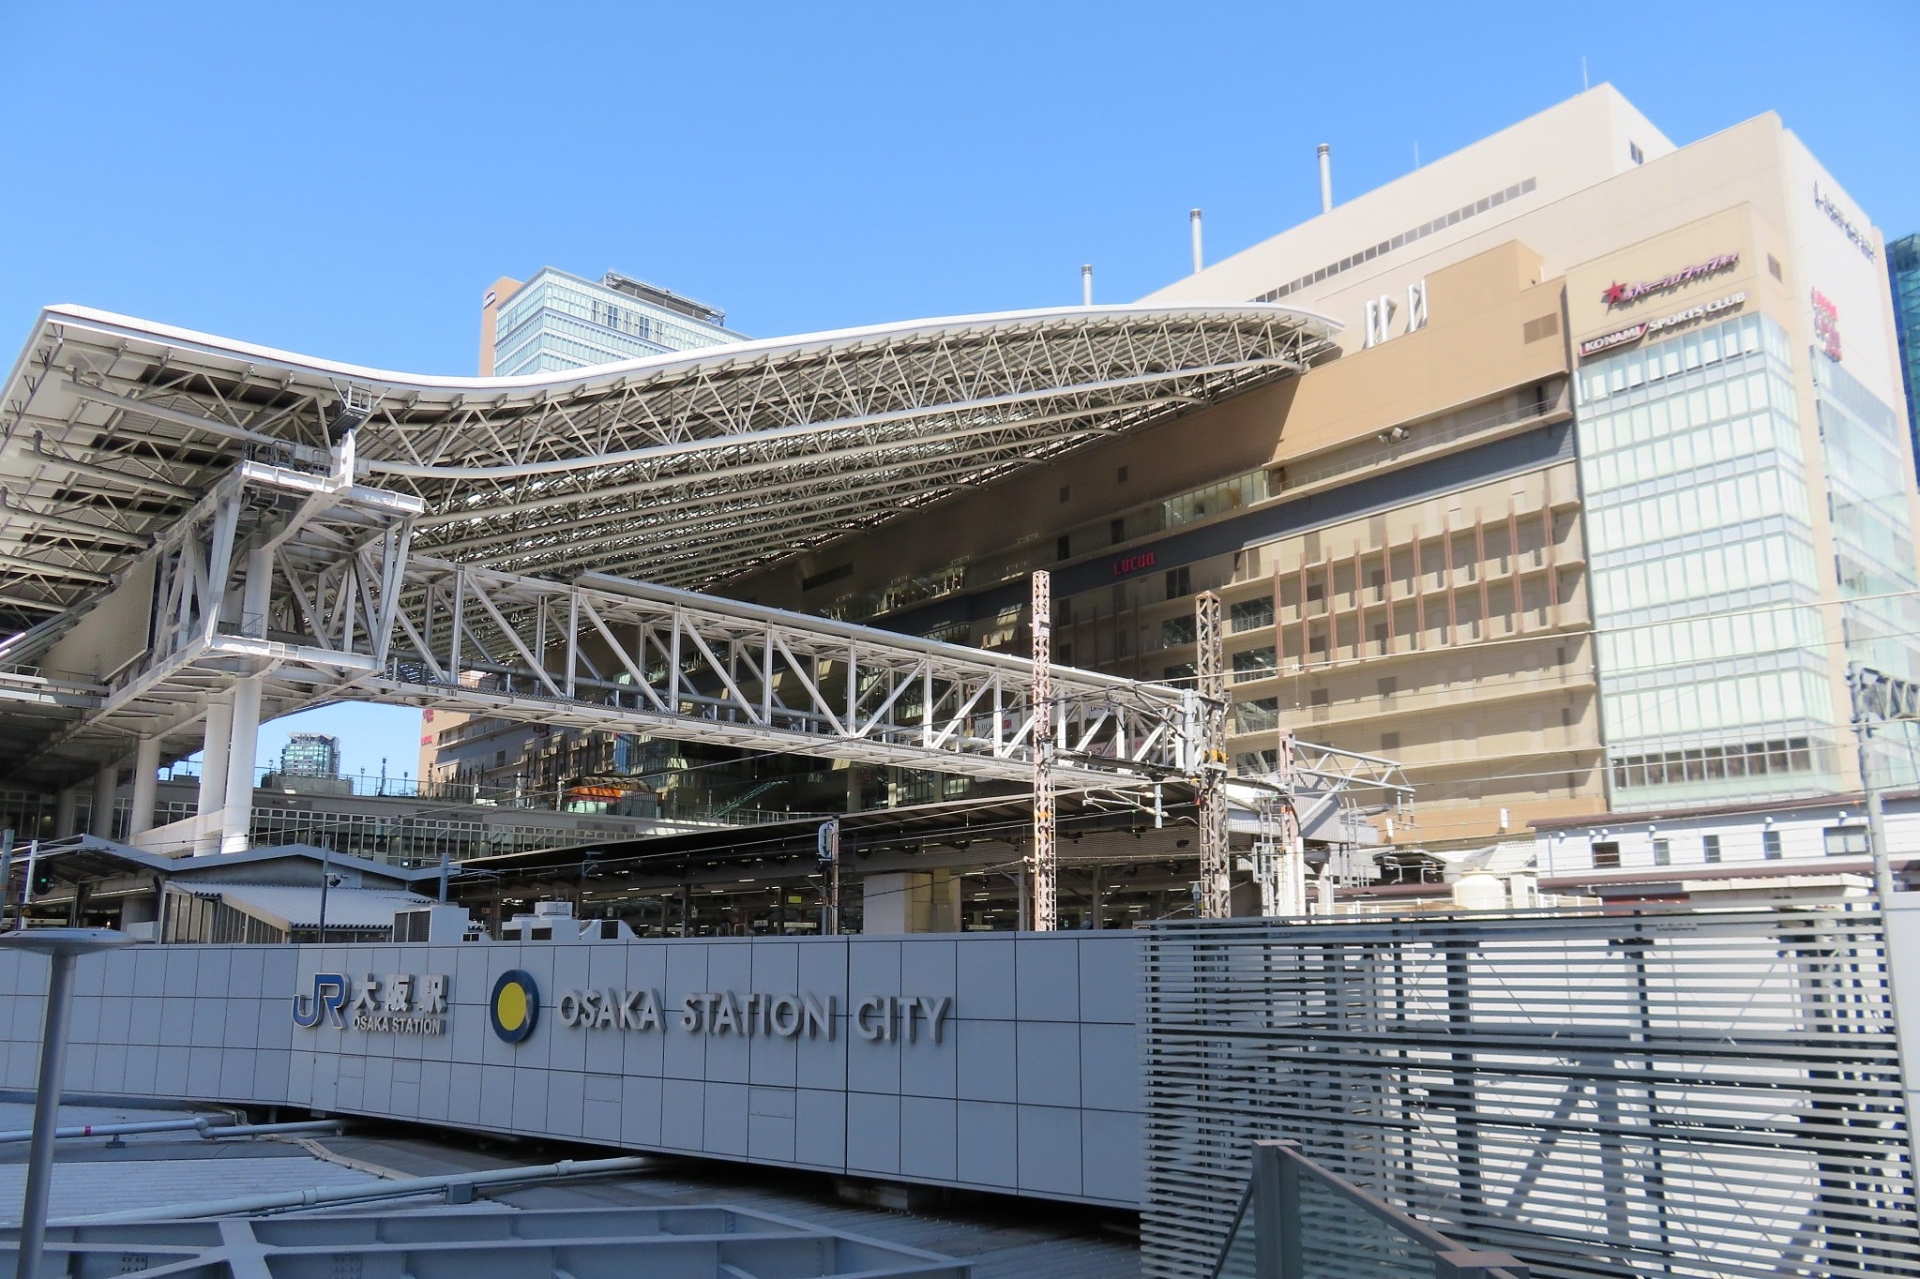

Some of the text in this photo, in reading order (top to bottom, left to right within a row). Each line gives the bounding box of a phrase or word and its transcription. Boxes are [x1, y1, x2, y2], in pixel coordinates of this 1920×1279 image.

[1584, 291, 1746, 352] KONAMI SPORTS CLUB
[293, 972, 350, 1030] JR
[353, 972, 449, 1014] 大阪駅
[560, 987, 952, 1044] OSAKA STATION CITY
[352, 1014, 445, 1036] OSAKA STATION
